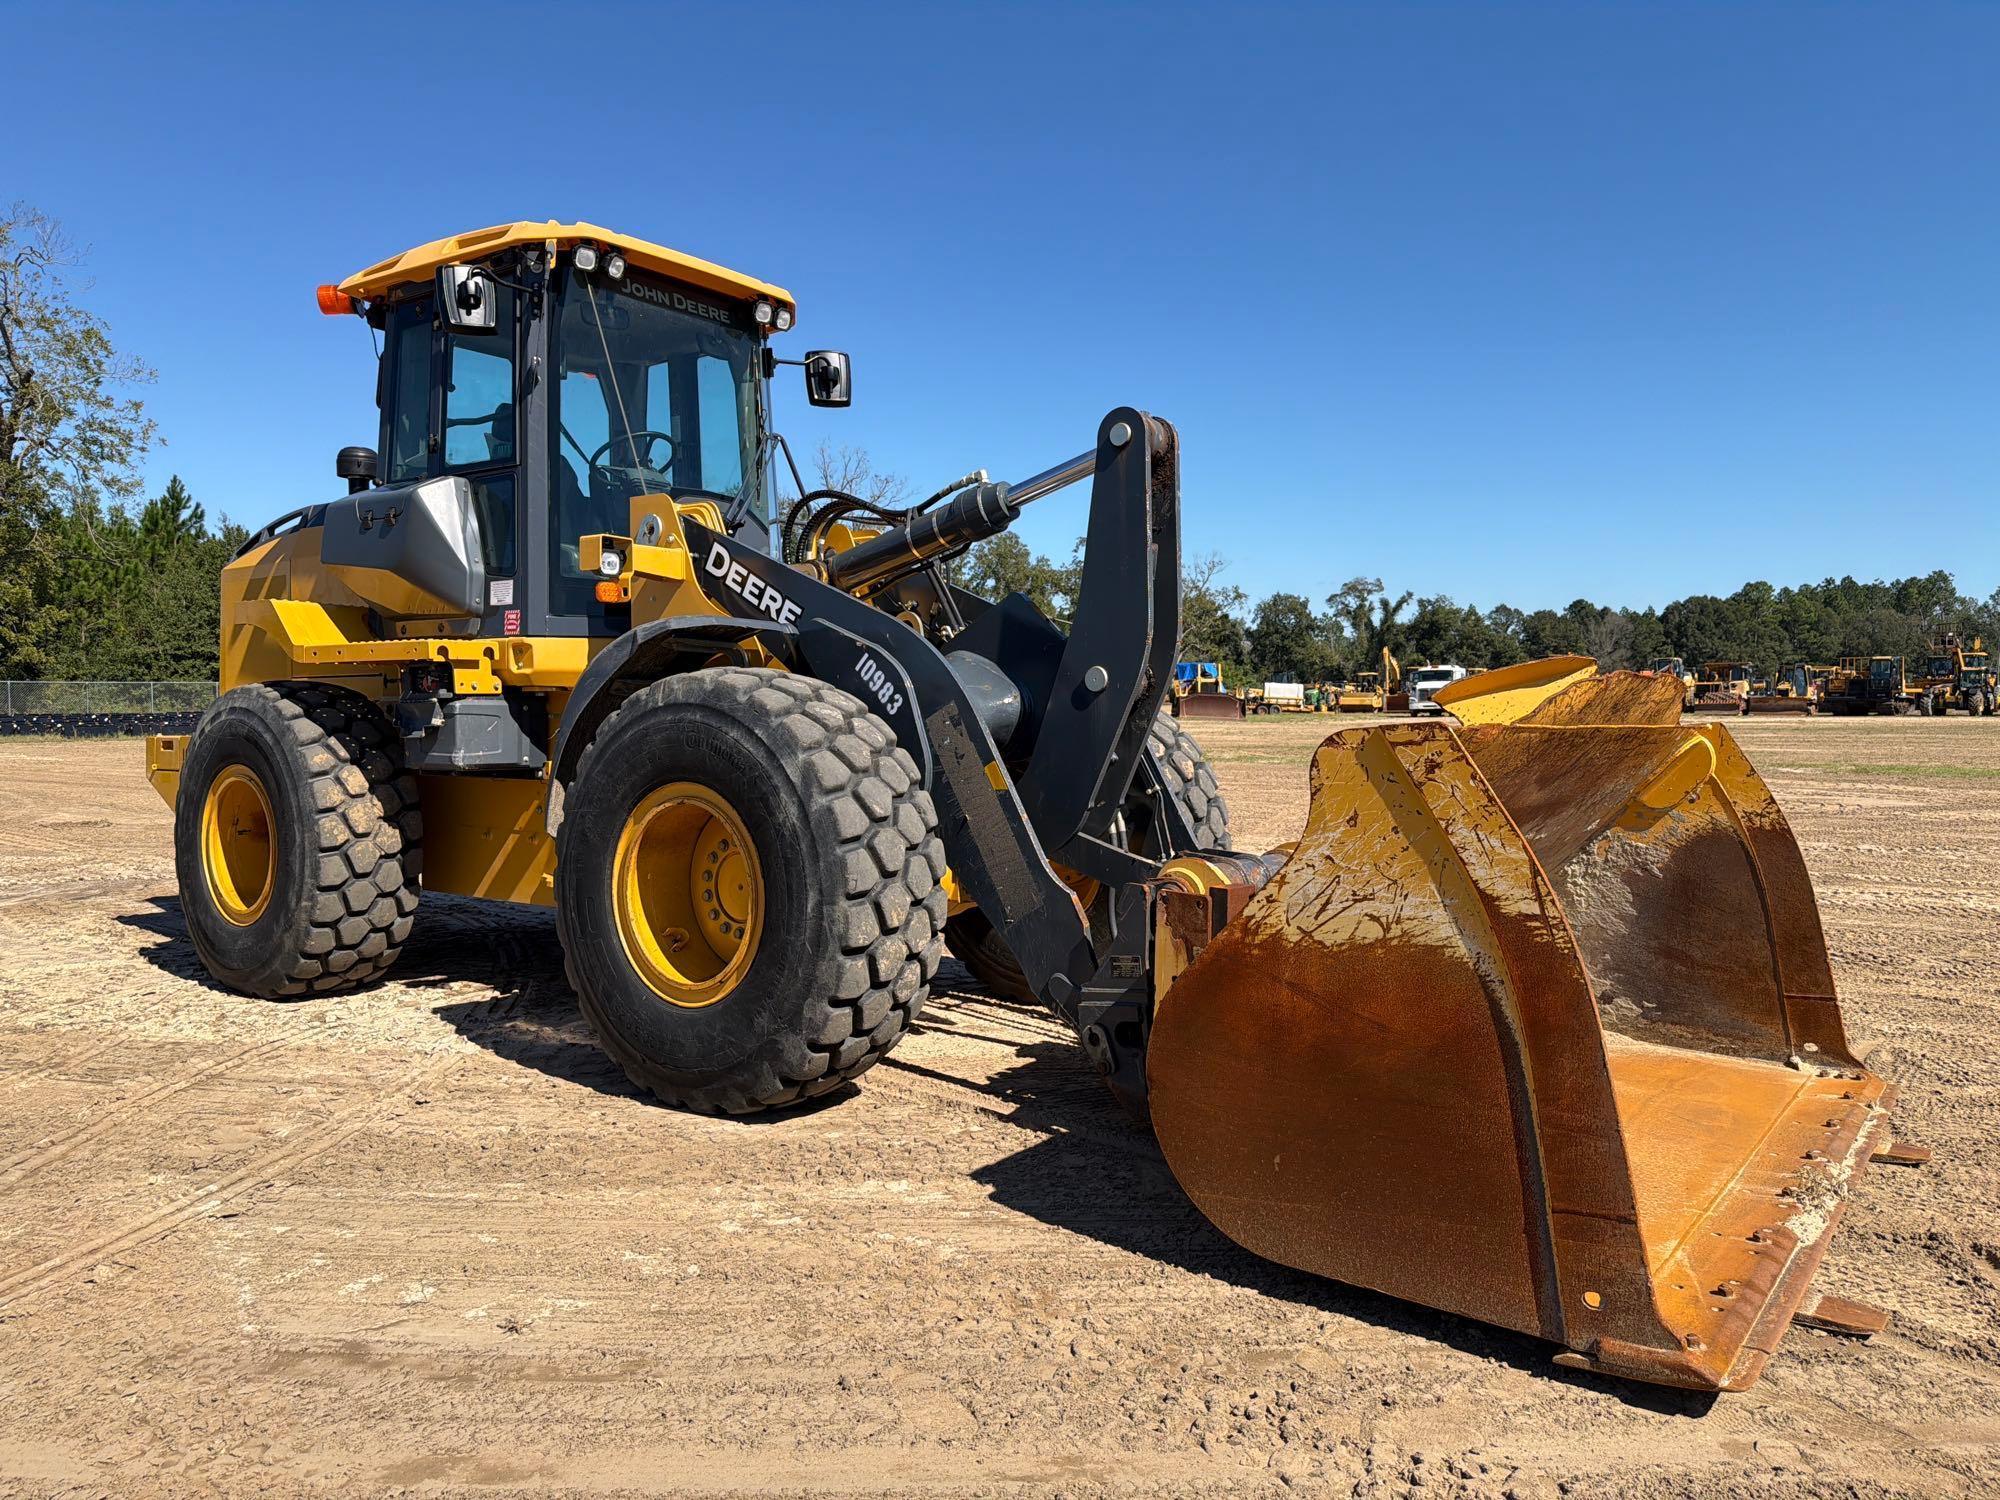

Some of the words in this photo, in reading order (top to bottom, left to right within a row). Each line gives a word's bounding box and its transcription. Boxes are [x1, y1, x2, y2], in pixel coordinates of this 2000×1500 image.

[621, 278, 670, 306] JOHN
[673, 293, 731, 323] DEERE
[705, 541, 803, 625] DEERE
[854, 652, 903, 716] 10983
